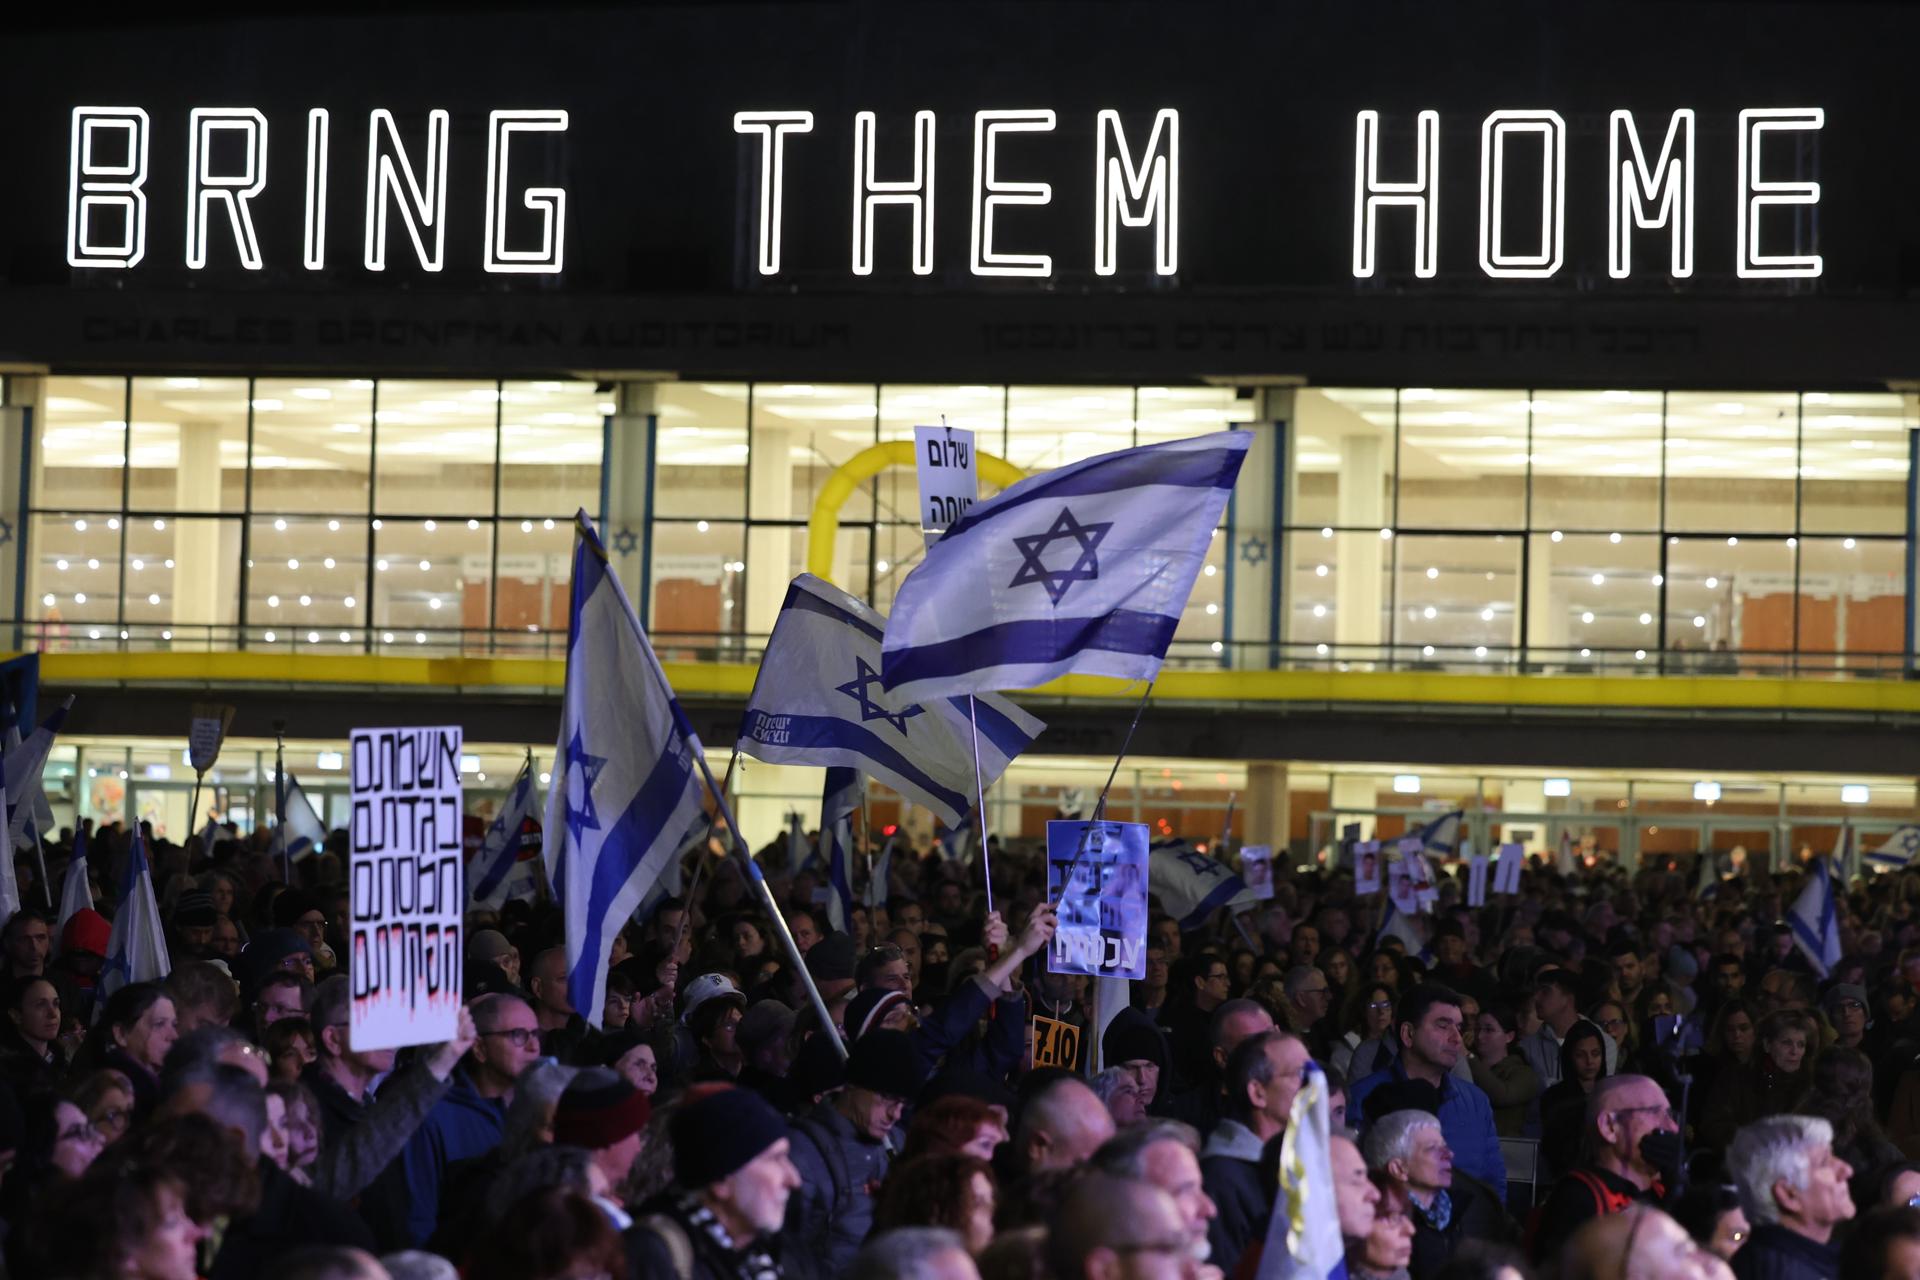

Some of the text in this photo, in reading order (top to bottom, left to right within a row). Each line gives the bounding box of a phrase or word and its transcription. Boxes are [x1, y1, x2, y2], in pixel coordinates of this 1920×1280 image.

[67, 106, 1825, 279] BRING THEM HOME
[82, 317, 294, 344] CHARLES
[580, 321, 852, 349] AUDITORIUM
[927, 434, 968, 469] שלום
[354, 730, 460, 793] אשמתם
[354, 796, 459, 855] בגדתם
[354, 922, 459, 1010] הפקרתם
[1034, 1019, 1077, 1068] 7.10
